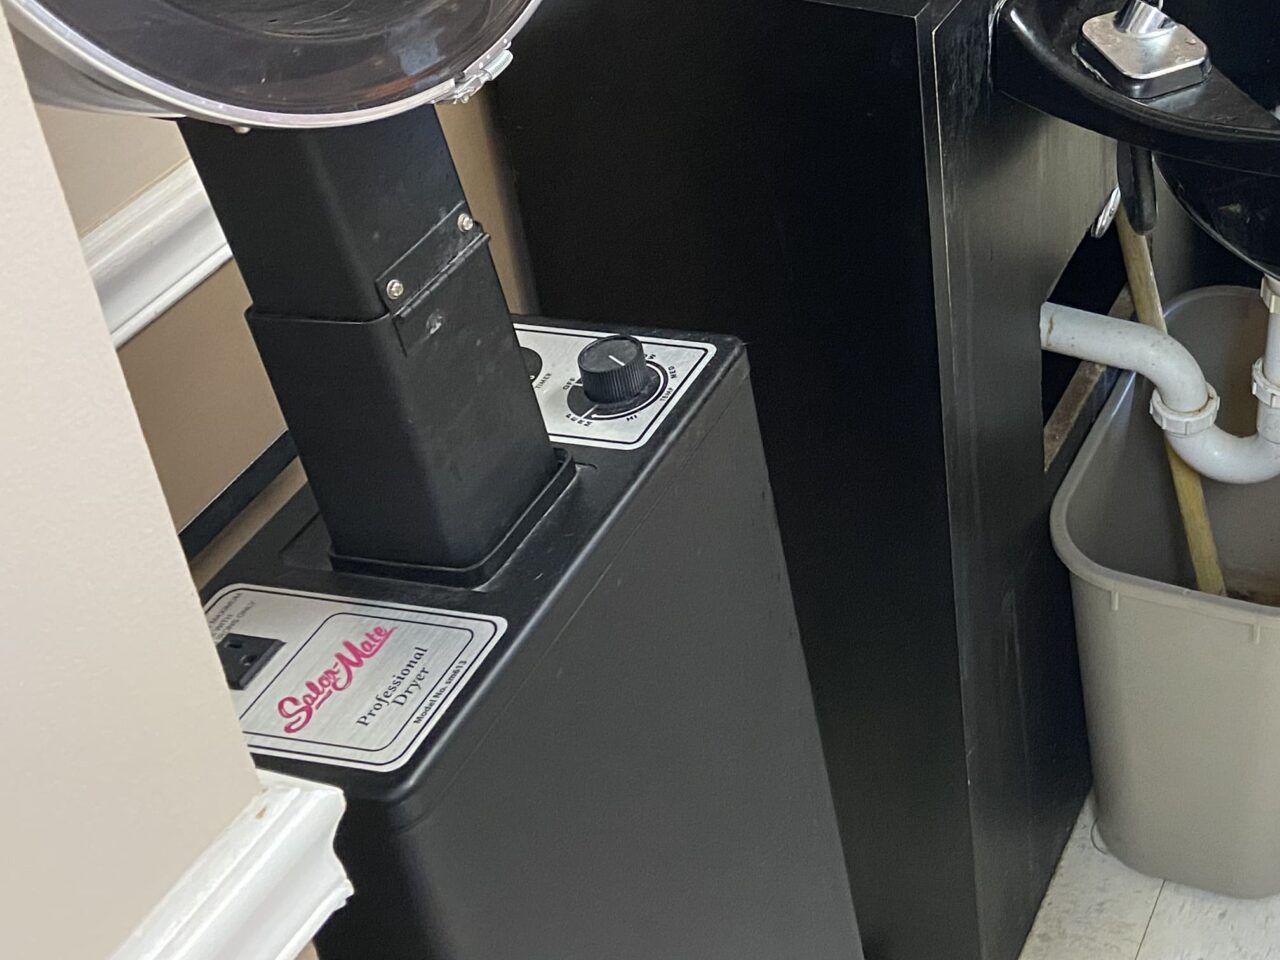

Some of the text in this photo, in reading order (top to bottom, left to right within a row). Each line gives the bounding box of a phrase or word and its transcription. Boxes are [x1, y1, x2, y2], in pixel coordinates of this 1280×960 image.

[535, 373, 552, 389] TIMER
[356, 646, 428, 726] Professional
[391, 667, 430, 706] Dryer
[413, 699, 437, 724] Model
